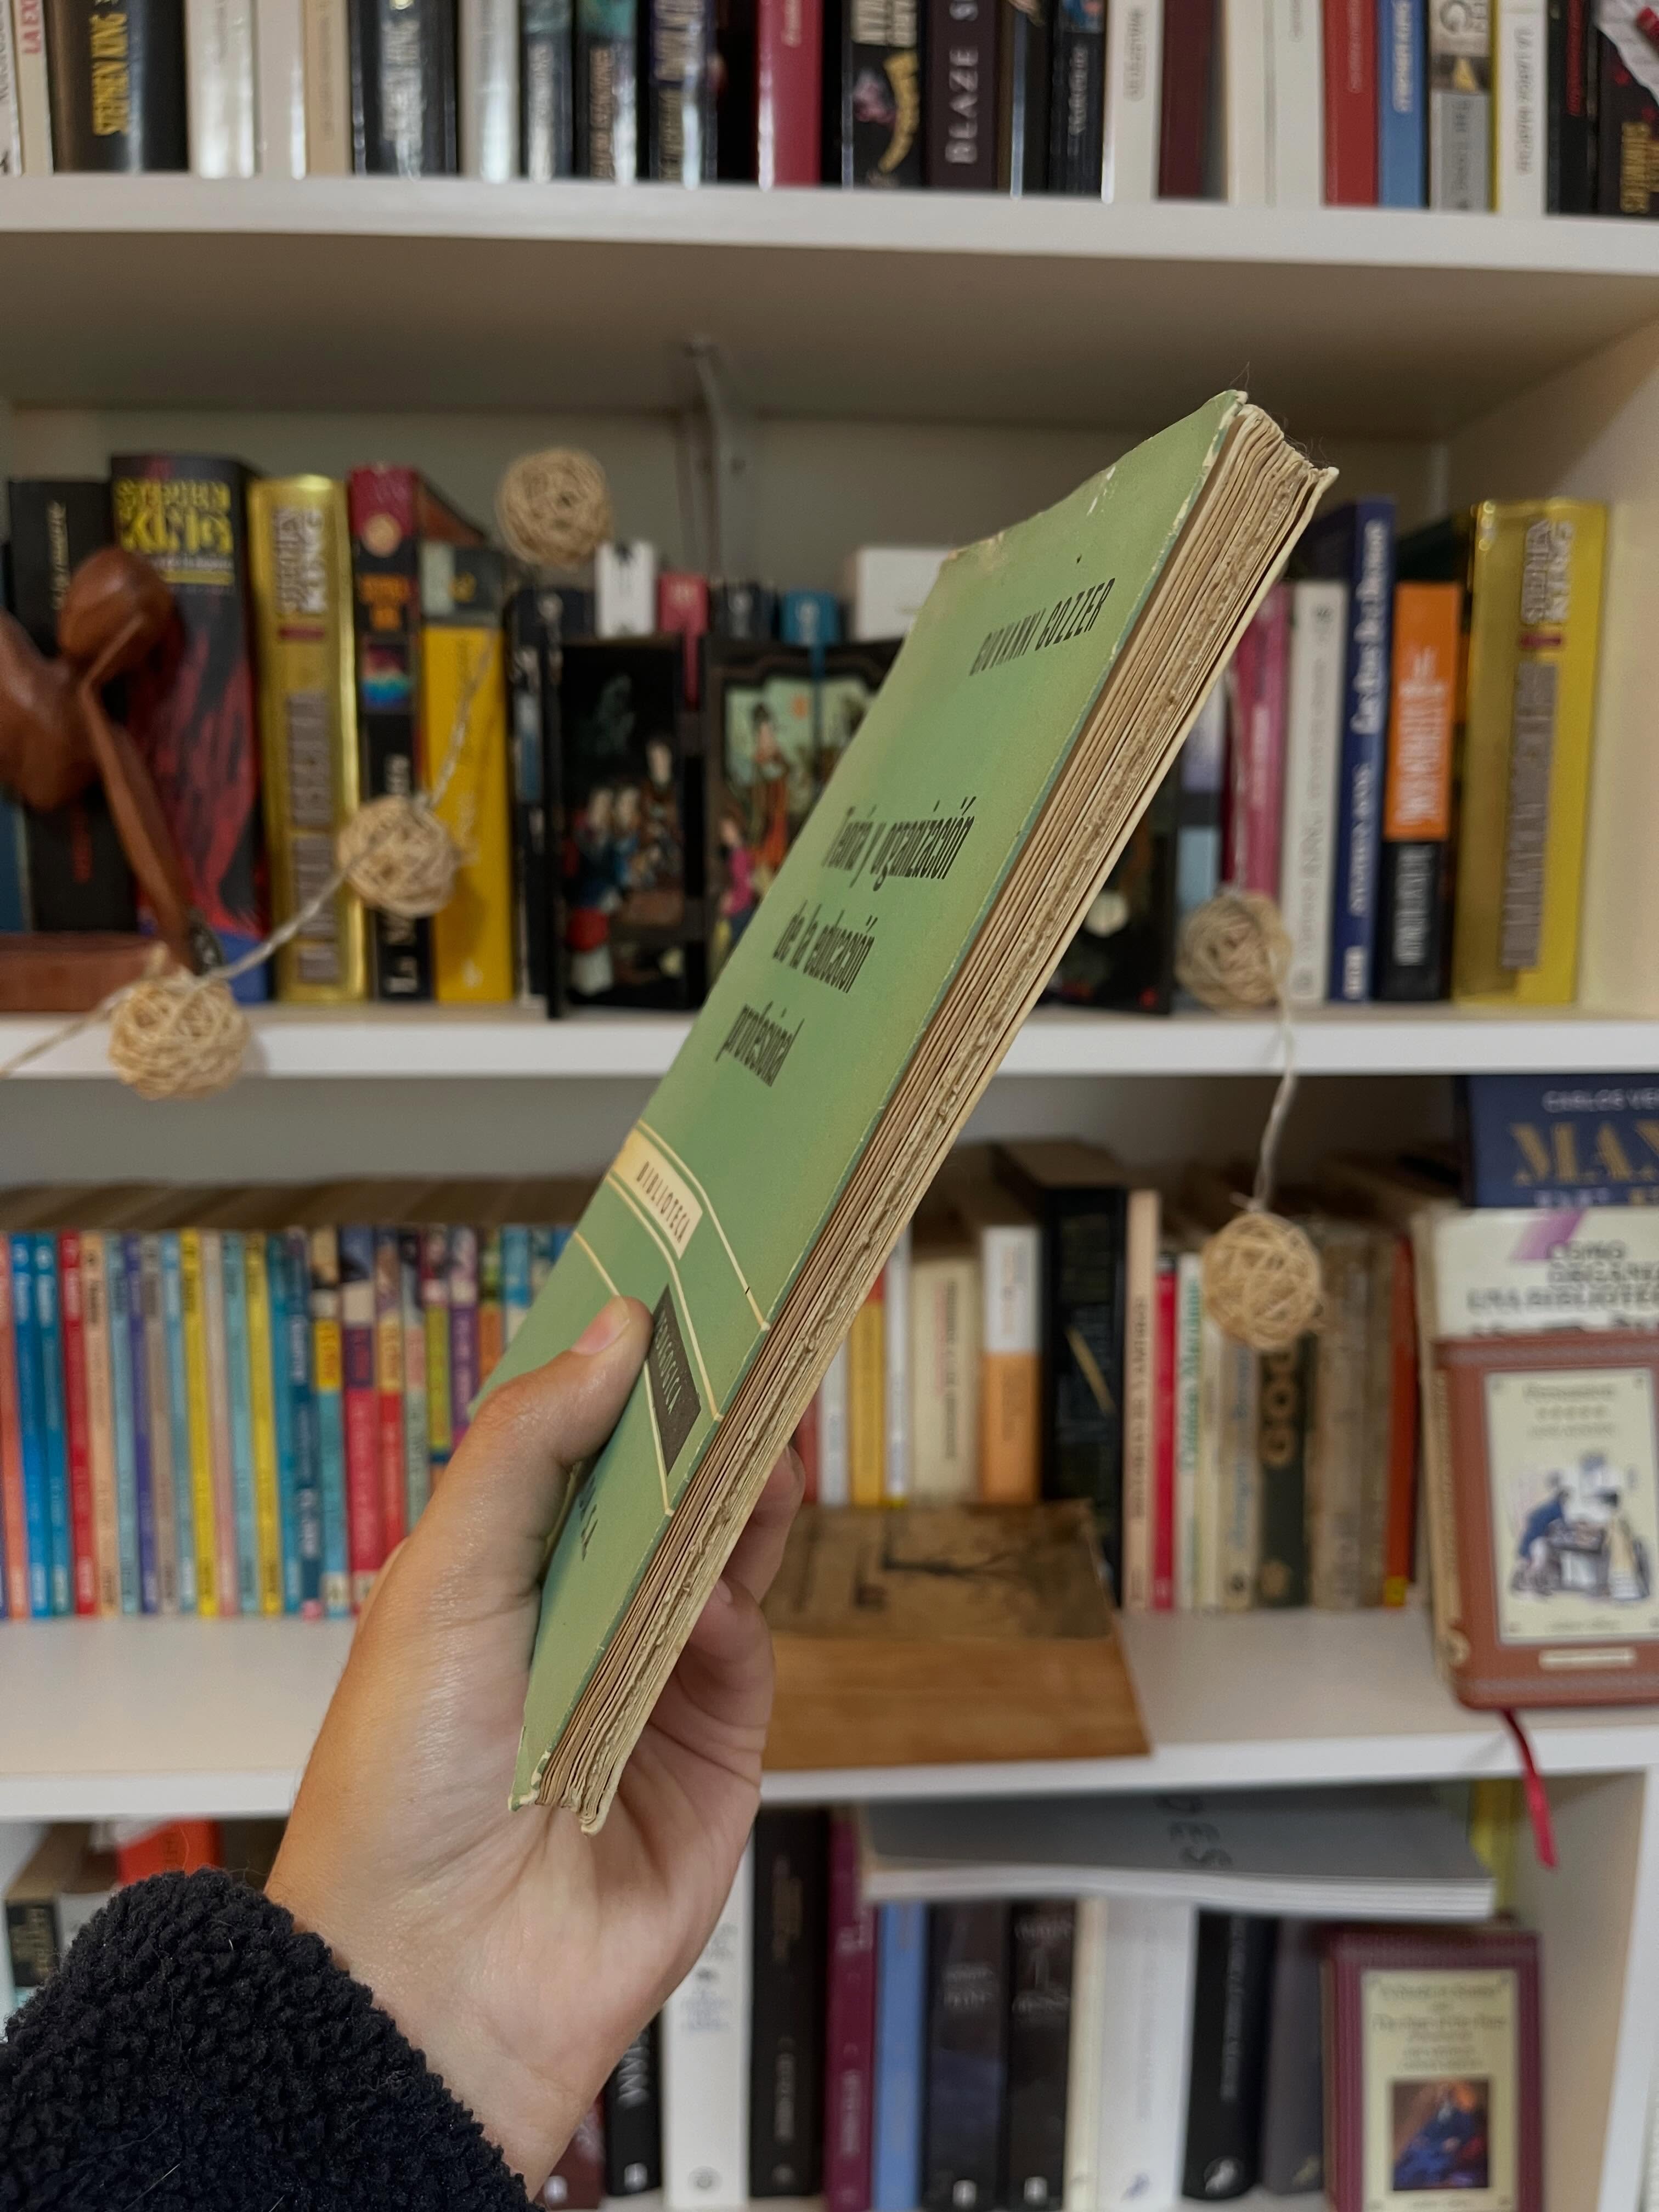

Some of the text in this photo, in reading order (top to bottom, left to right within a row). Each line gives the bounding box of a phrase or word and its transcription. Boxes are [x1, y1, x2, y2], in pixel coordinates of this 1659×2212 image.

[89, 13, 129, 136] STEPHEN KING
[945, 47, 978, 163] BLAZE
[969, 578, 1115, 676] GIOVANNI GOZZER
[821, 796, 977, 891] Teoría y organización
[772, 900, 878, 994] de la educación
[715, 1000, 805, 1087] profesional
[636, 1161, 690, 1243] BIBLIOTECA
